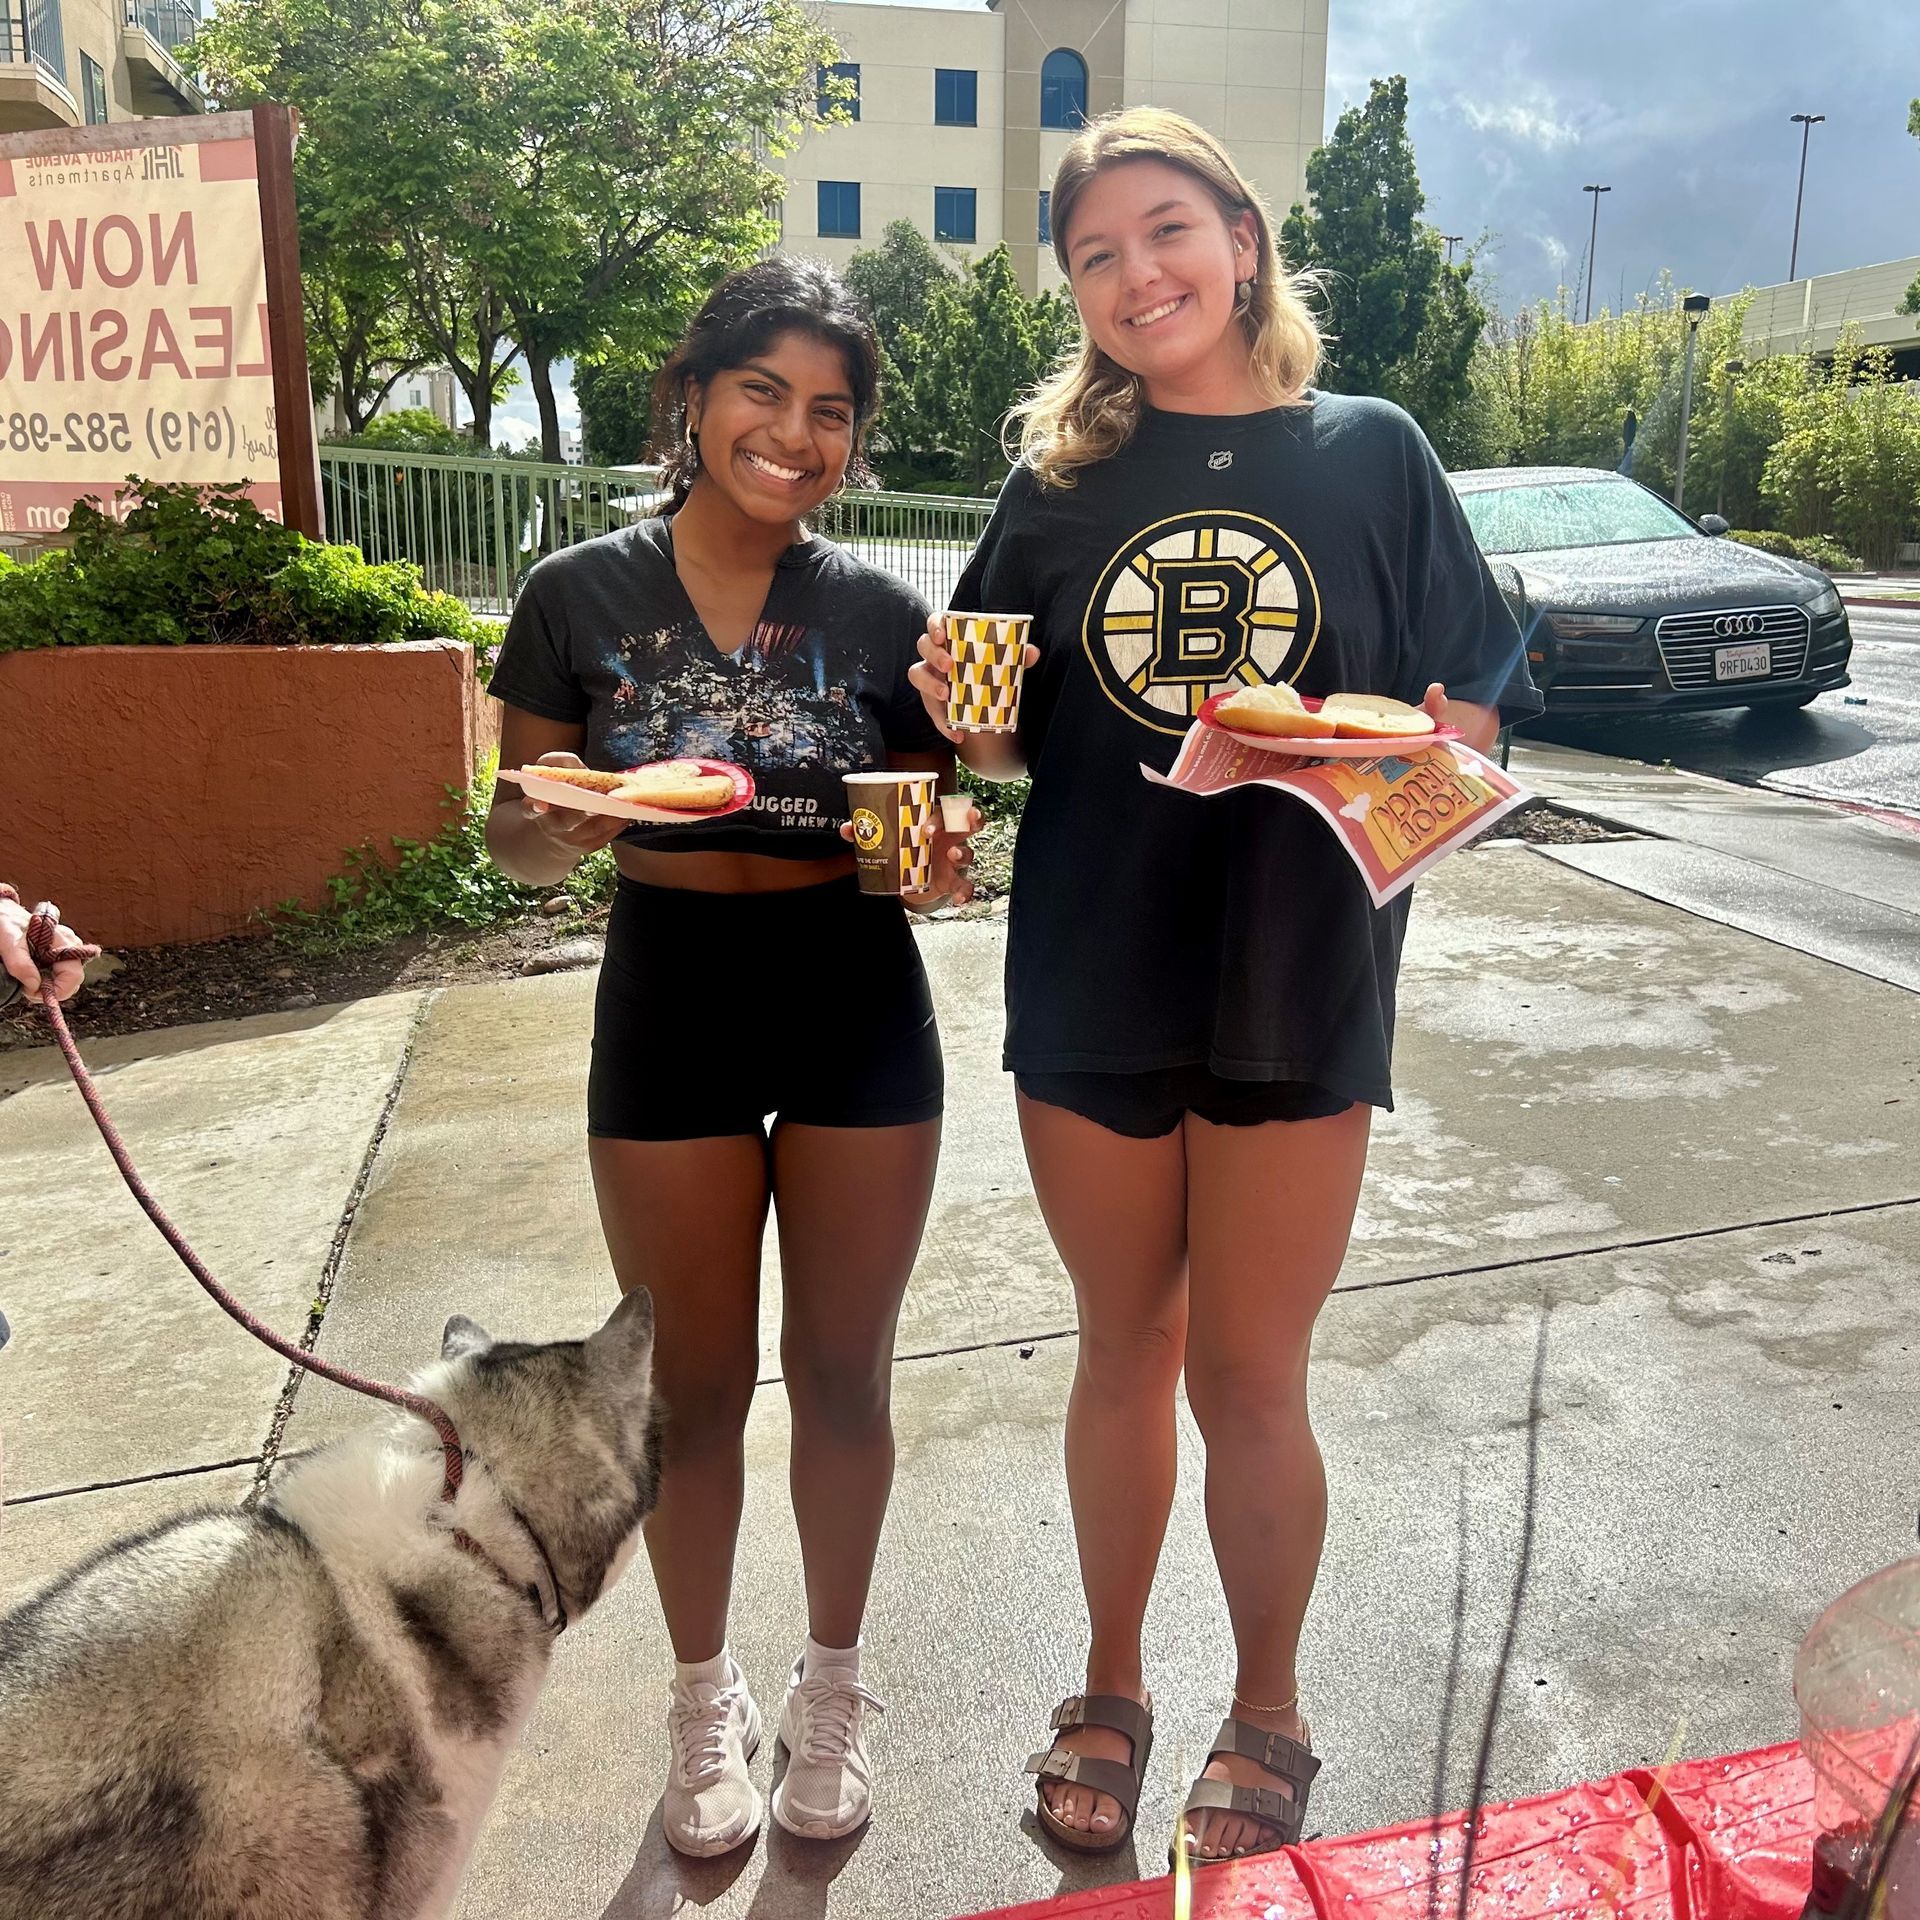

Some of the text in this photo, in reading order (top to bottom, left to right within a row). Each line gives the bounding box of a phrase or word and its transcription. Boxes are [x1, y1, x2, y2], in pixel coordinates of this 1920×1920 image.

[1150, 560, 1254, 682] B
[1719, 656, 1767, 675] 9RFD430
[744, 795, 818, 814] UGGED
[1376, 762, 1455, 834] TRUCK
[1400, 782, 1469, 848] FOOD
[781, 815, 795, 827] IN
[797, 816, 829, 828] NEW
